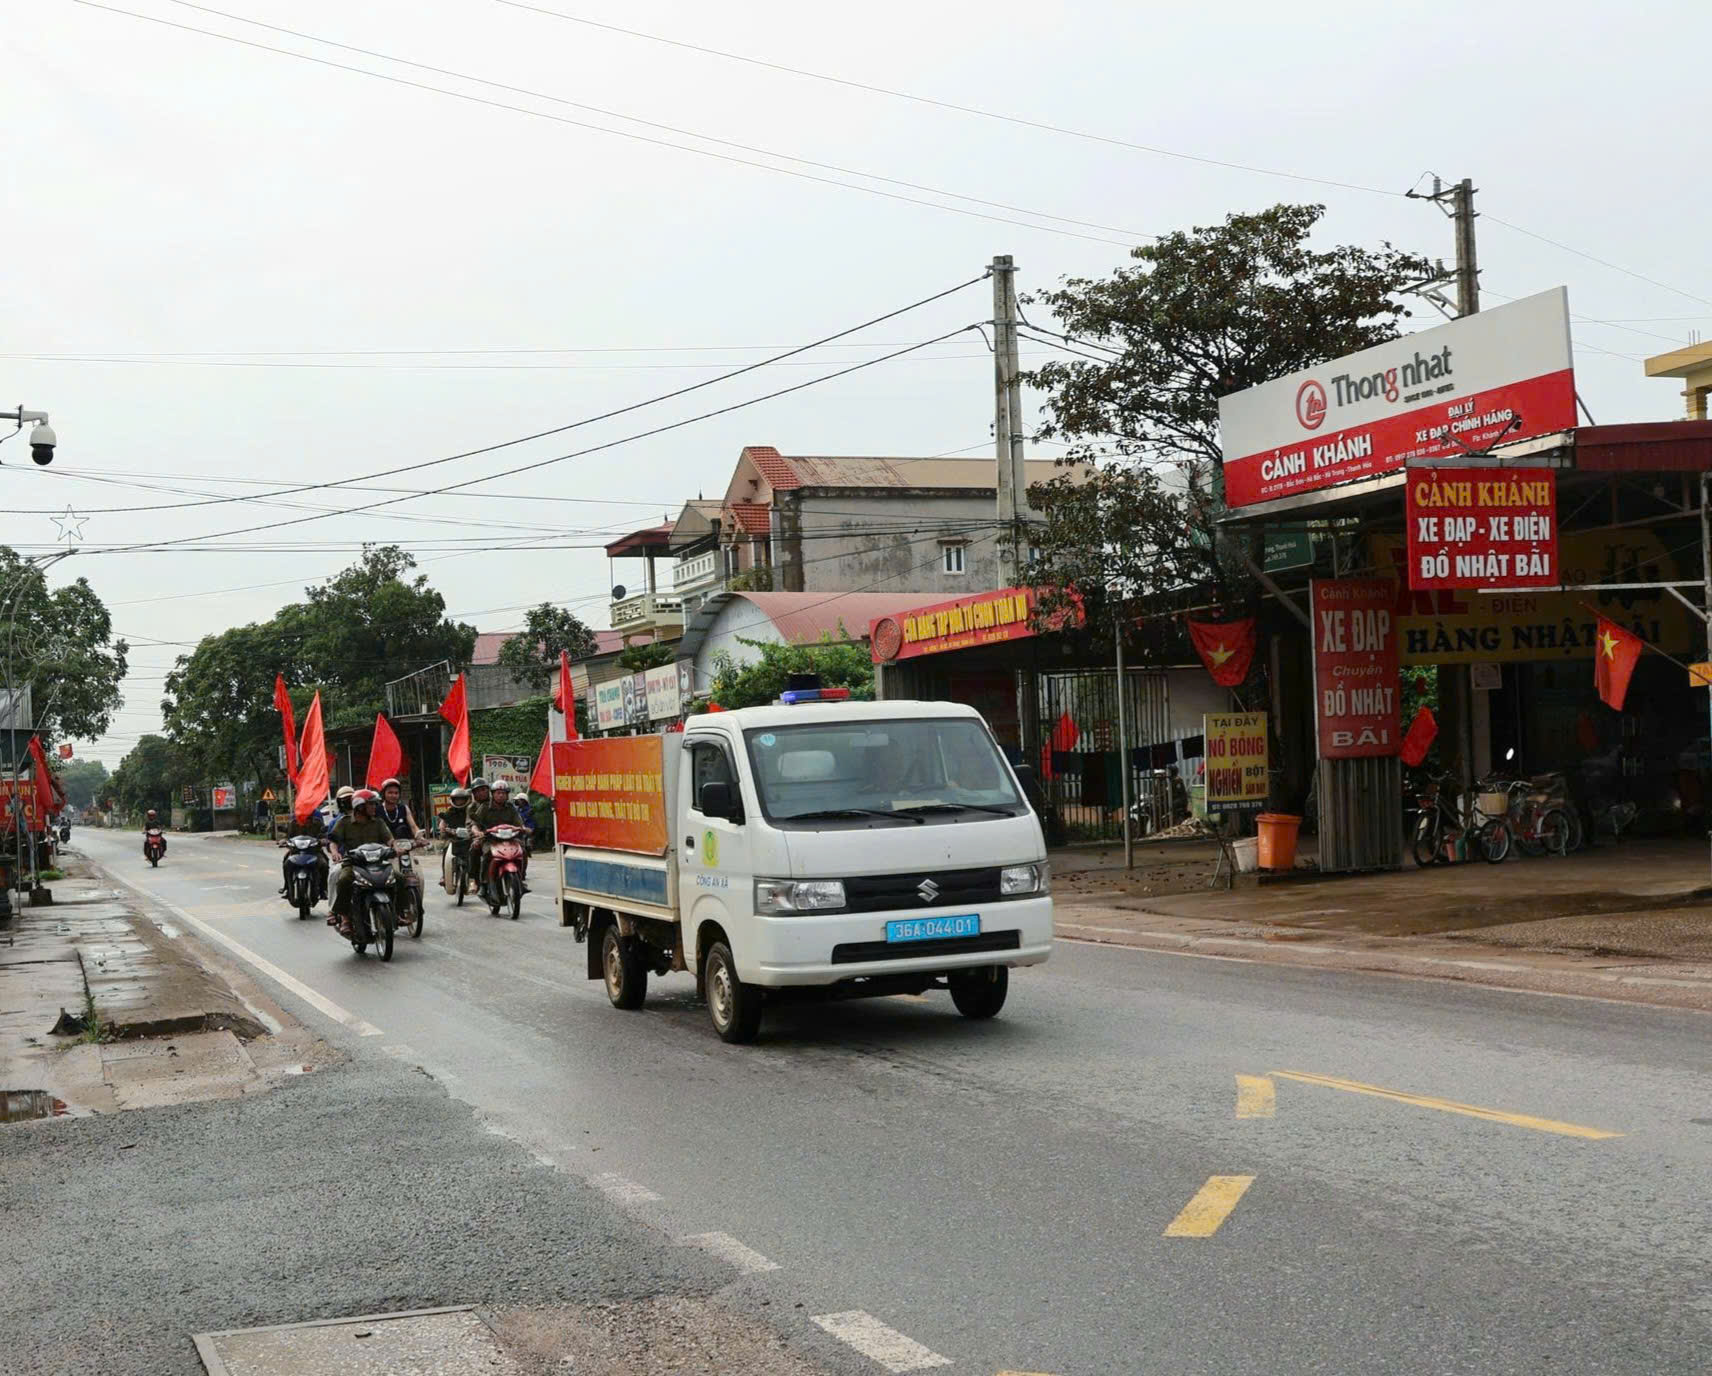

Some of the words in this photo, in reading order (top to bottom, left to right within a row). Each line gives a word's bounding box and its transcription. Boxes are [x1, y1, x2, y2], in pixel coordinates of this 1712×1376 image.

[1416, 430, 1428, 444] XE
[1451, 415, 1481, 434] CHÍNH
[1261, 450, 1306, 481] CẢNH
[1313, 433, 1372, 469] KHÁNH
[1415, 473, 1472, 507] CẢNH
[1478, 474, 1550, 507] KHÁNH
[1417, 518, 1439, 543] XE
[1444, 517, 1475, 547] ĐẠP
[1489, 516, 1509, 542] XE
[1514, 511, 1550, 546] ĐIỆN
[1420, 547, 1449, 579] ĐỒ
[1456, 550, 1509, 582] NHẬT
[1515, 548, 1550, 577] BÃI
[1321, 610, 1346, 653] XE
[1352, 609, 1391, 662] ĐẠP
[1405, 621, 1501, 654] HÀNG
[1352, 684, 1394, 721] NHẬT
[1332, 726, 1390, 748] BÃI
